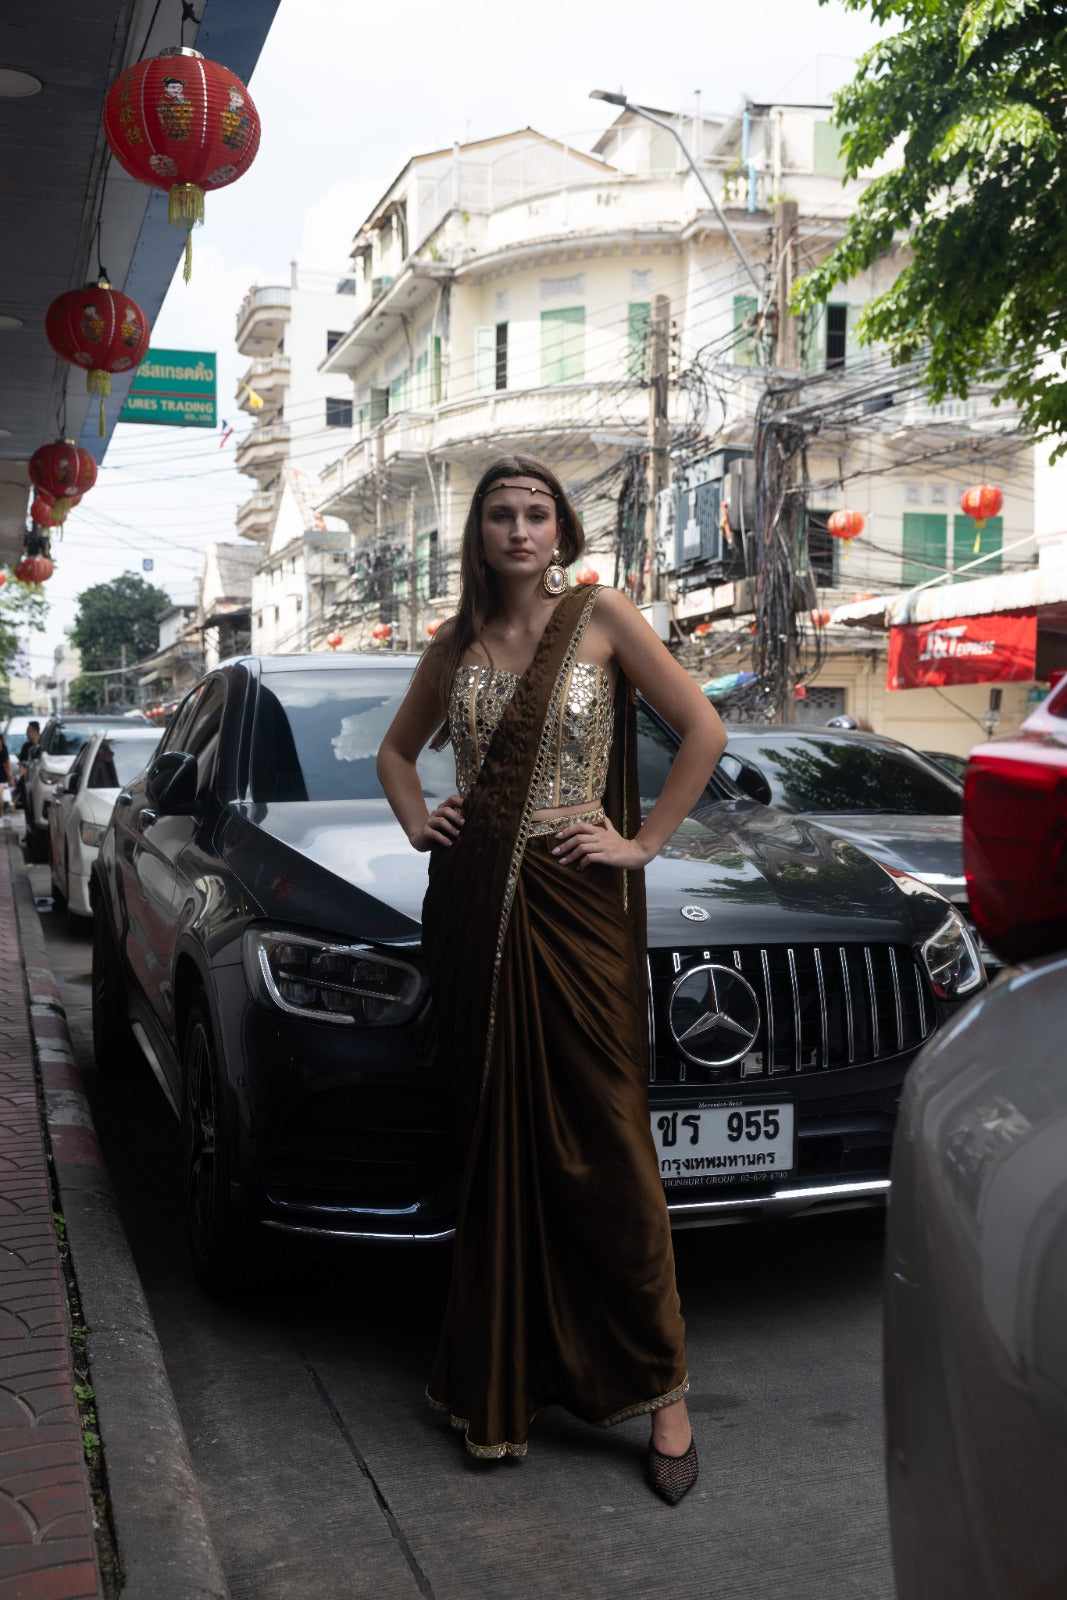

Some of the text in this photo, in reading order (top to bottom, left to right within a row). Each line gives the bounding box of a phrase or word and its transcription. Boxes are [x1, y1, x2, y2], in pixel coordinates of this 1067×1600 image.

[126, 398, 214, 413] URES TRADING
[920, 625, 995, 661] J&T EXPRESS
[657, 1108, 780, 1147] ชร 955
[661, 1152, 776, 1175] กรุงเทพมหานคร
[705, 1175, 735, 1184] GROUP
